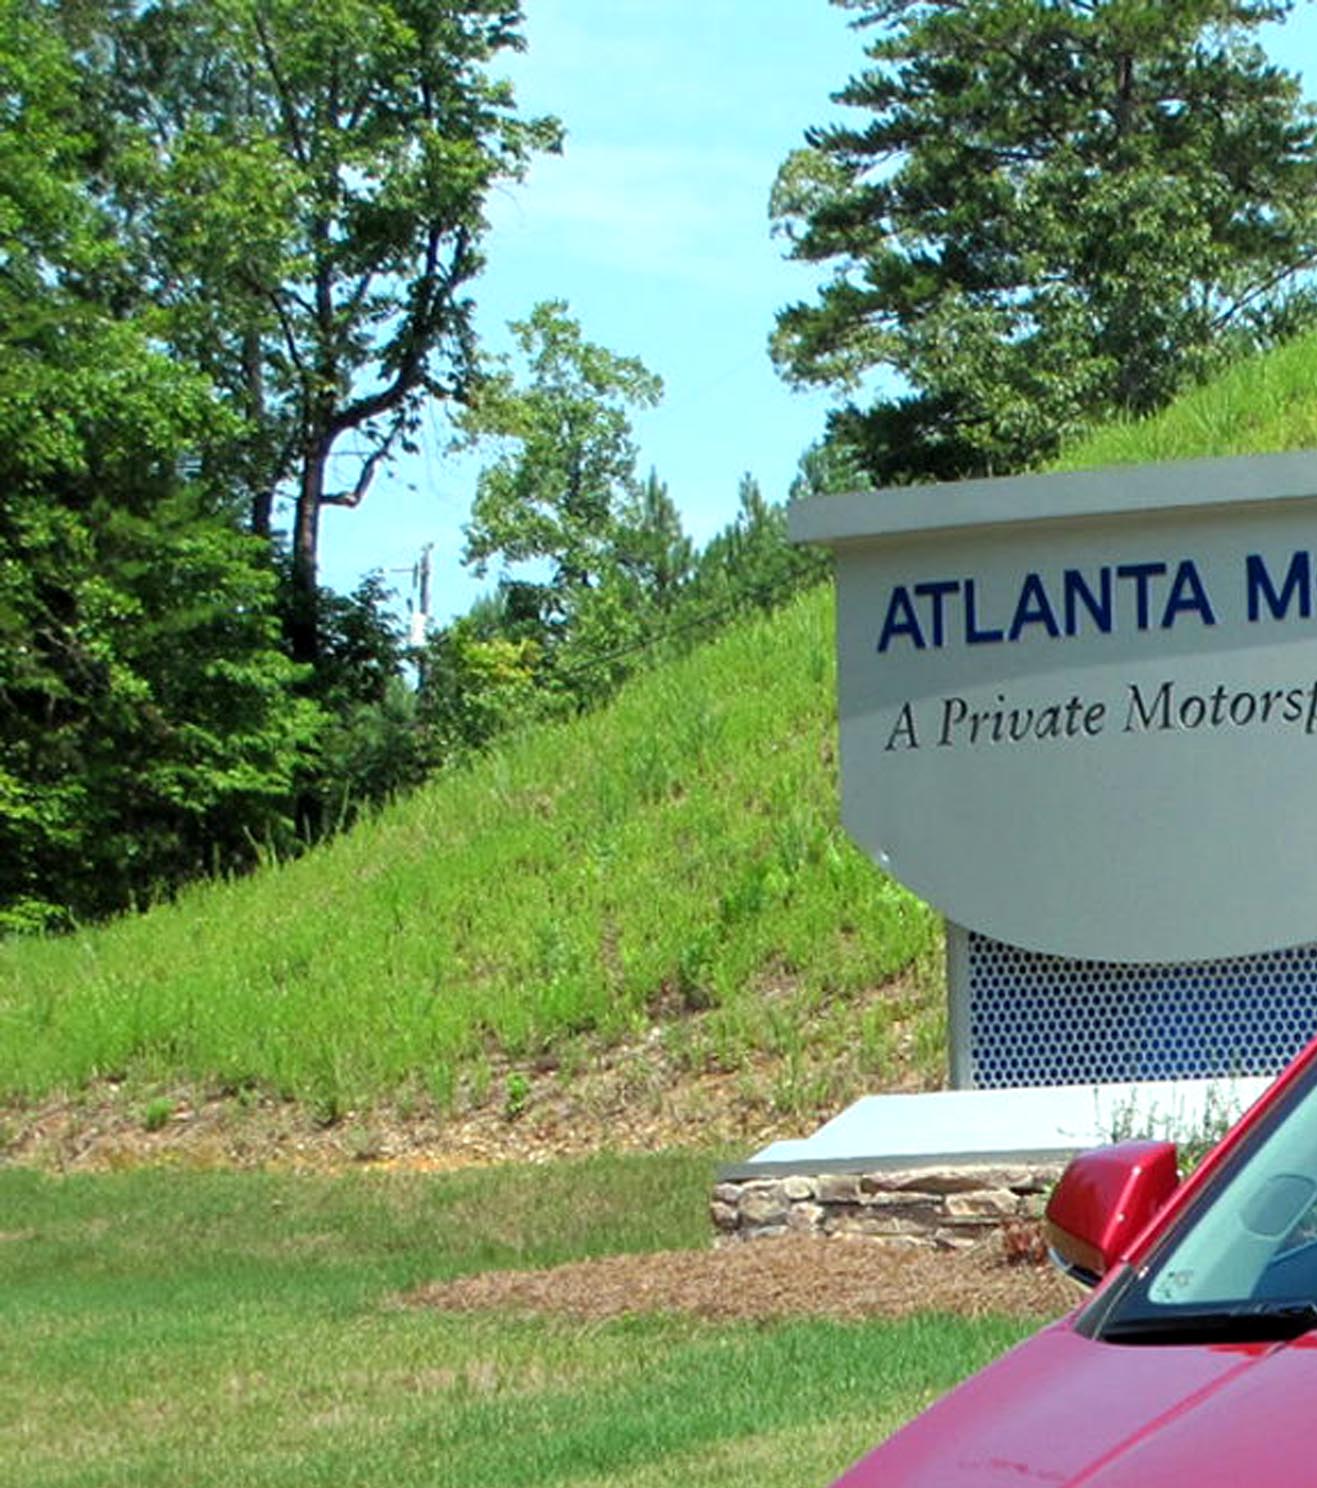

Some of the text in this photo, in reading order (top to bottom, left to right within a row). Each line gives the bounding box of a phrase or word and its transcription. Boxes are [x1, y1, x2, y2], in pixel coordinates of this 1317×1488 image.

[877, 558, 1217, 654] ATLANTA
[884, 701, 920, 752] A
[936, 693, 1107, 748] Private
